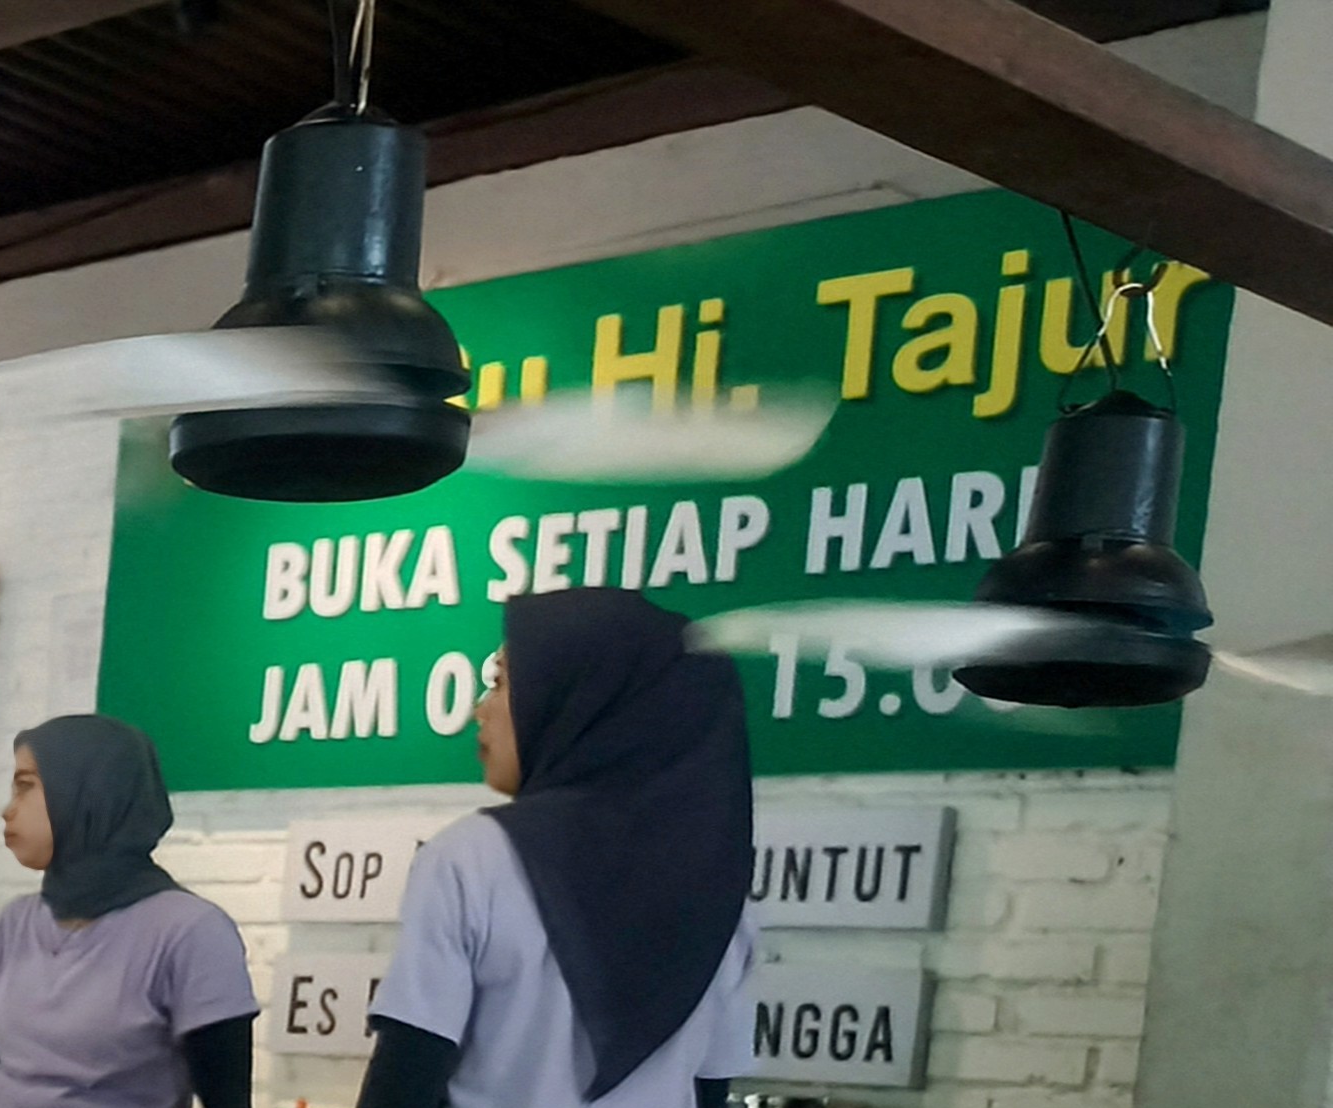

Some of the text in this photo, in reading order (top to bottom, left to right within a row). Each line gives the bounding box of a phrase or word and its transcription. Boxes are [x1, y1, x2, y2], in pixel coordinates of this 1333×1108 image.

[817, 249, 1211, 418] Tajur
[263, 525, 460, 620] BUKA
[487, 496, 770, 602] SETIAP
[249, 657, 398, 744] JAM
